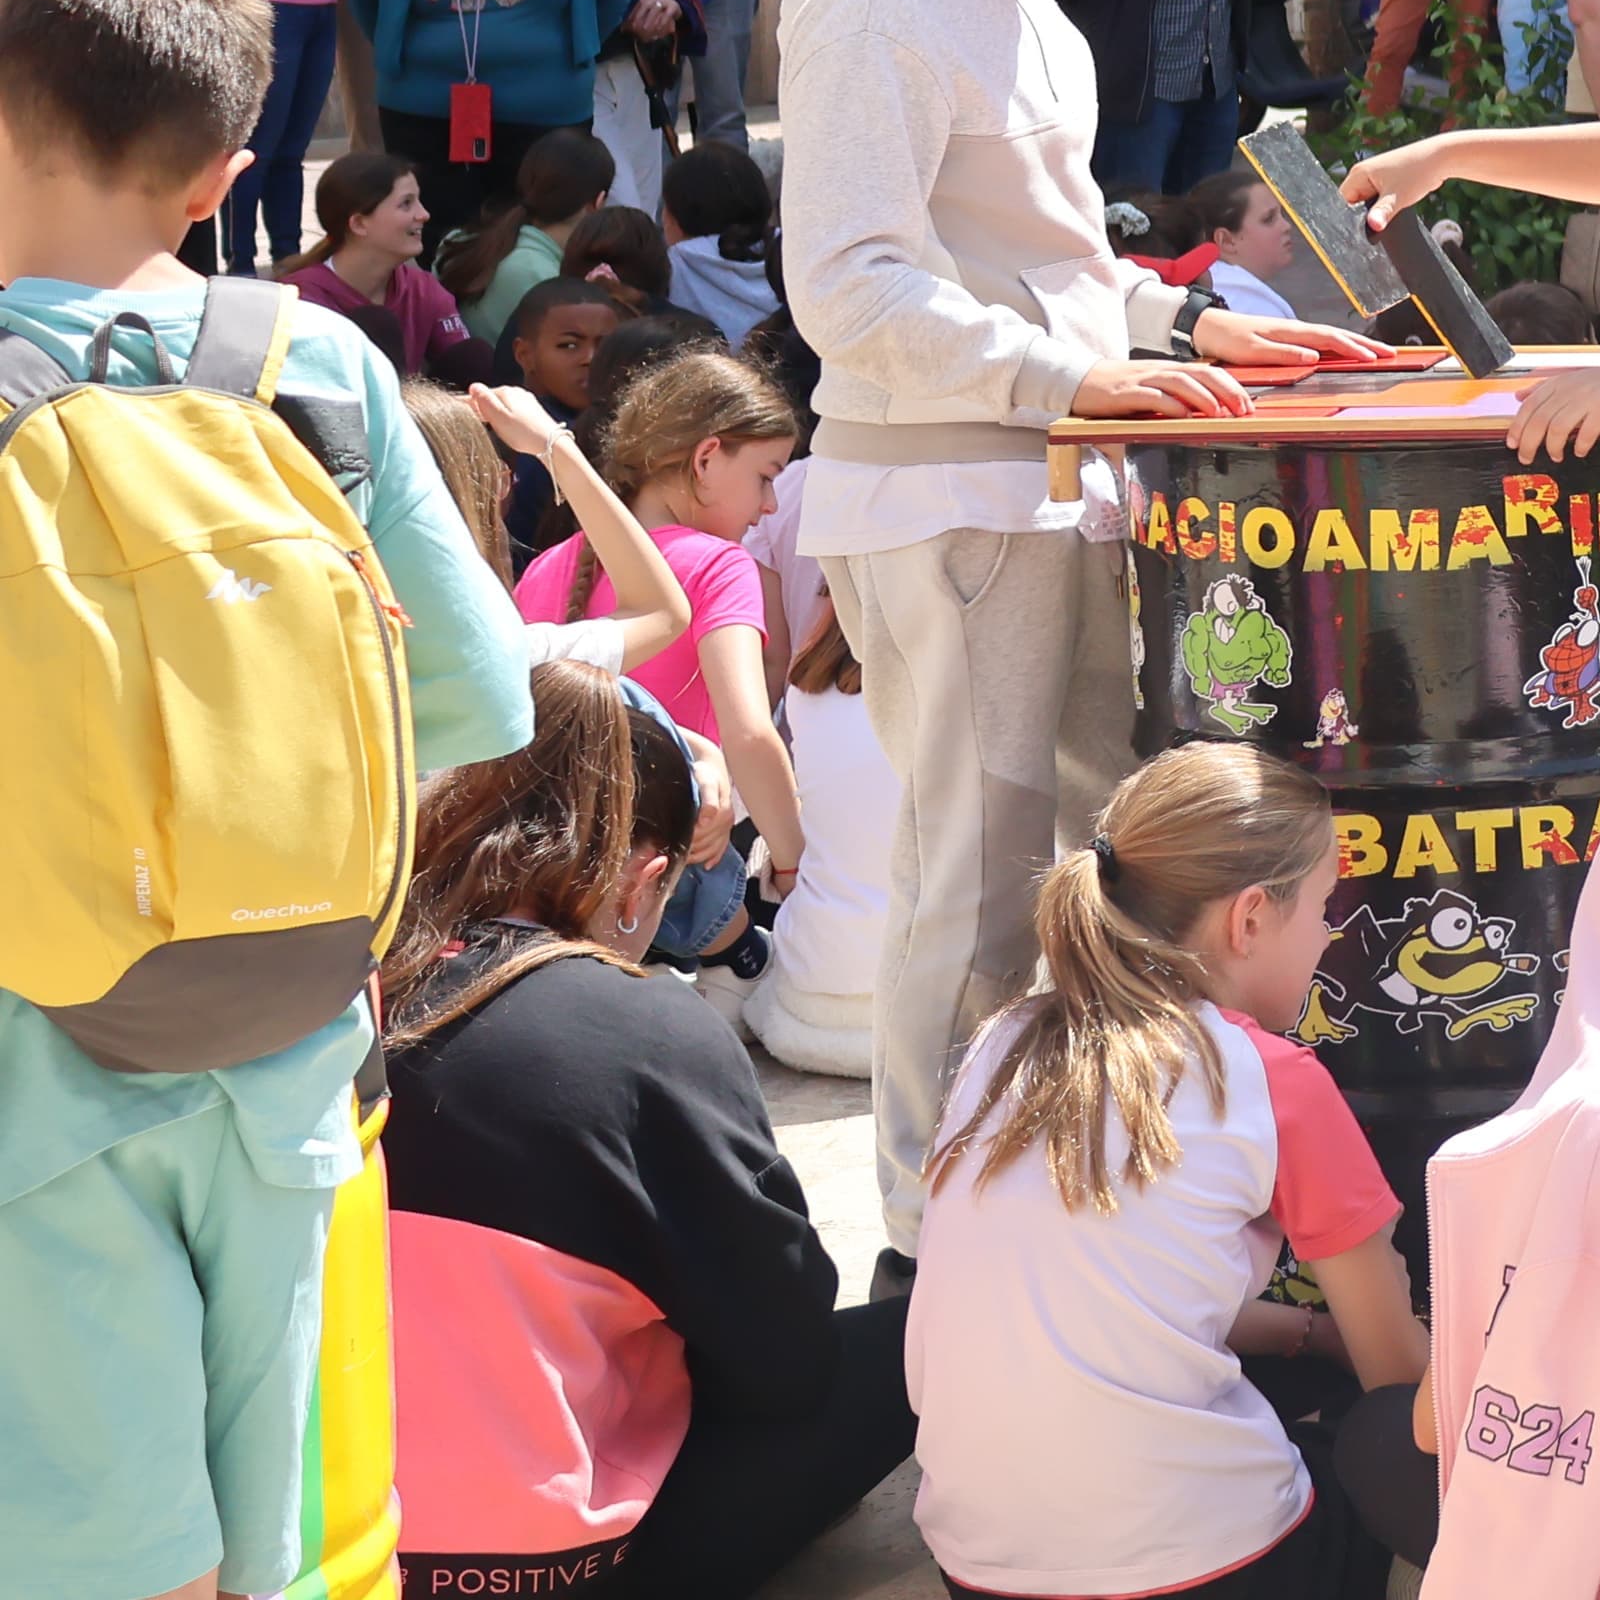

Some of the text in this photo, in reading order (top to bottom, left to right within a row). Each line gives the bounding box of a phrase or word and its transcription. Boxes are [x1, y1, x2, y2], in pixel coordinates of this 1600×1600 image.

[135, 865, 153, 917] ARPENAZ
[230, 900, 333, 922] Quechua
[1465, 1384, 1596, 1486] 624
[432, 1552, 602, 1594] POSITIVE
